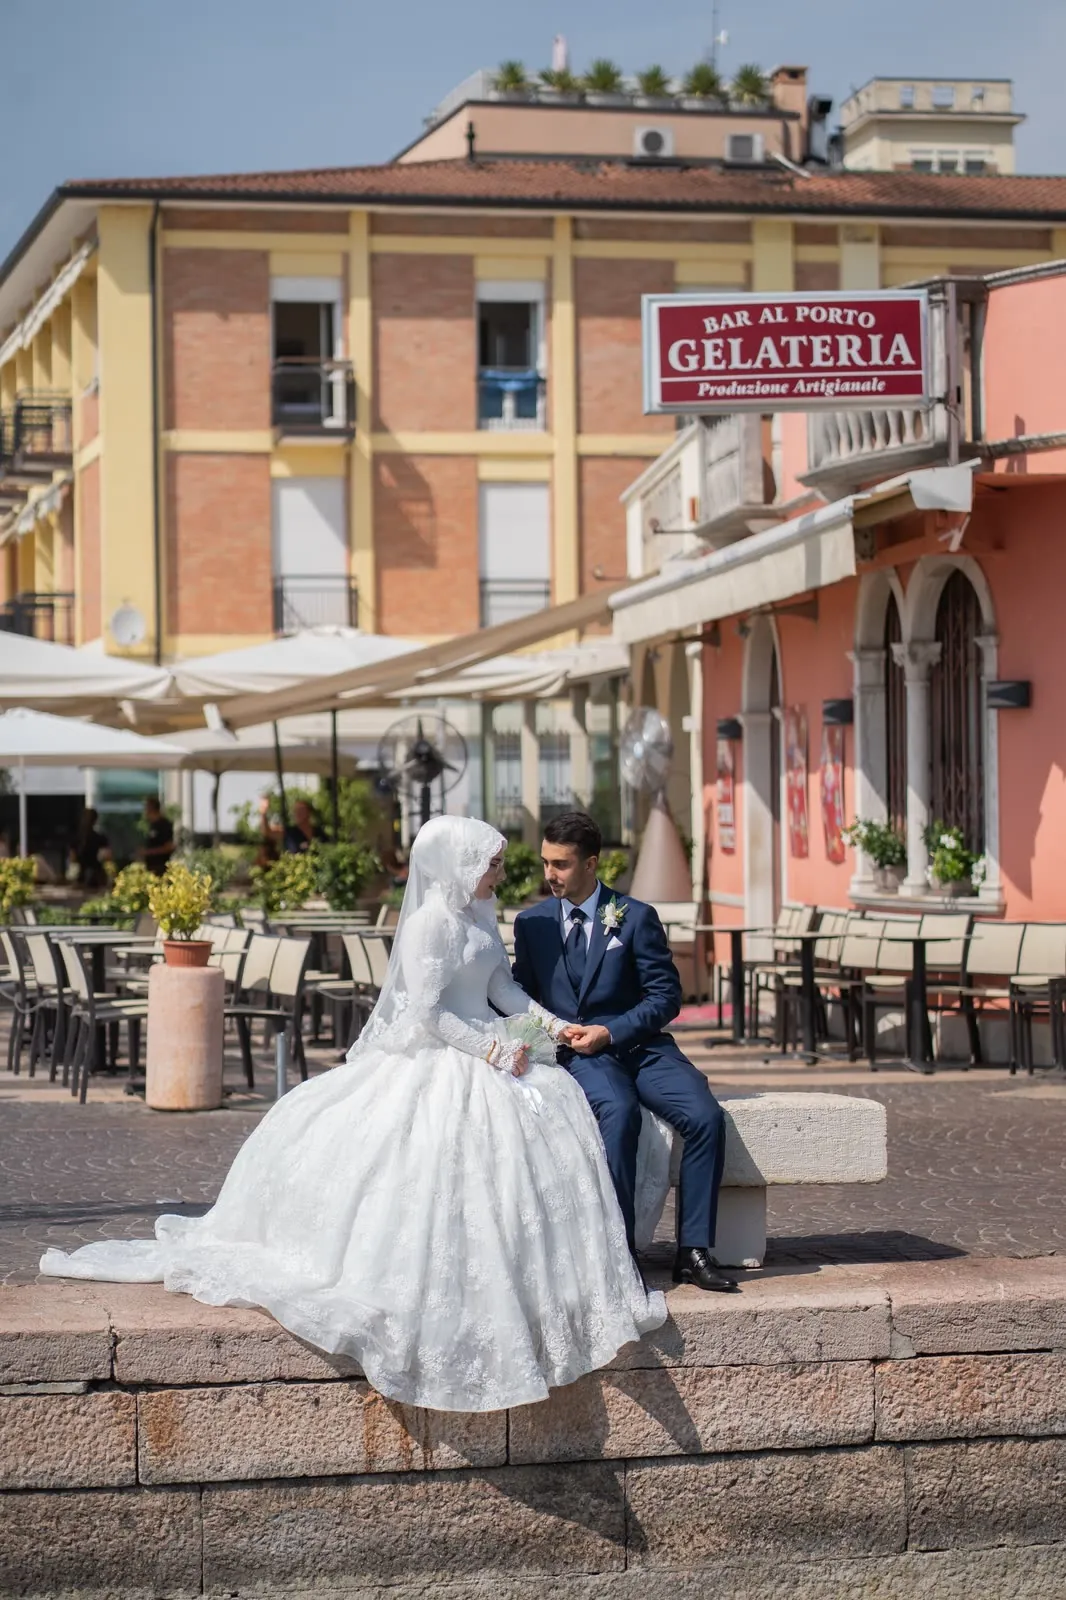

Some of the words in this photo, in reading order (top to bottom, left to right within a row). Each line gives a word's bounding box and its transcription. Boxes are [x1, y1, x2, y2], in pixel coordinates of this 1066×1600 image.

[703, 310, 753, 334] BAR
[759, 307, 788, 323] AL
[796, 306, 875, 328] PORTO
[668, 333, 916, 372] GELATERIA
[698, 382, 789, 396] Produzione
[793, 377, 886, 396] Artigianale
